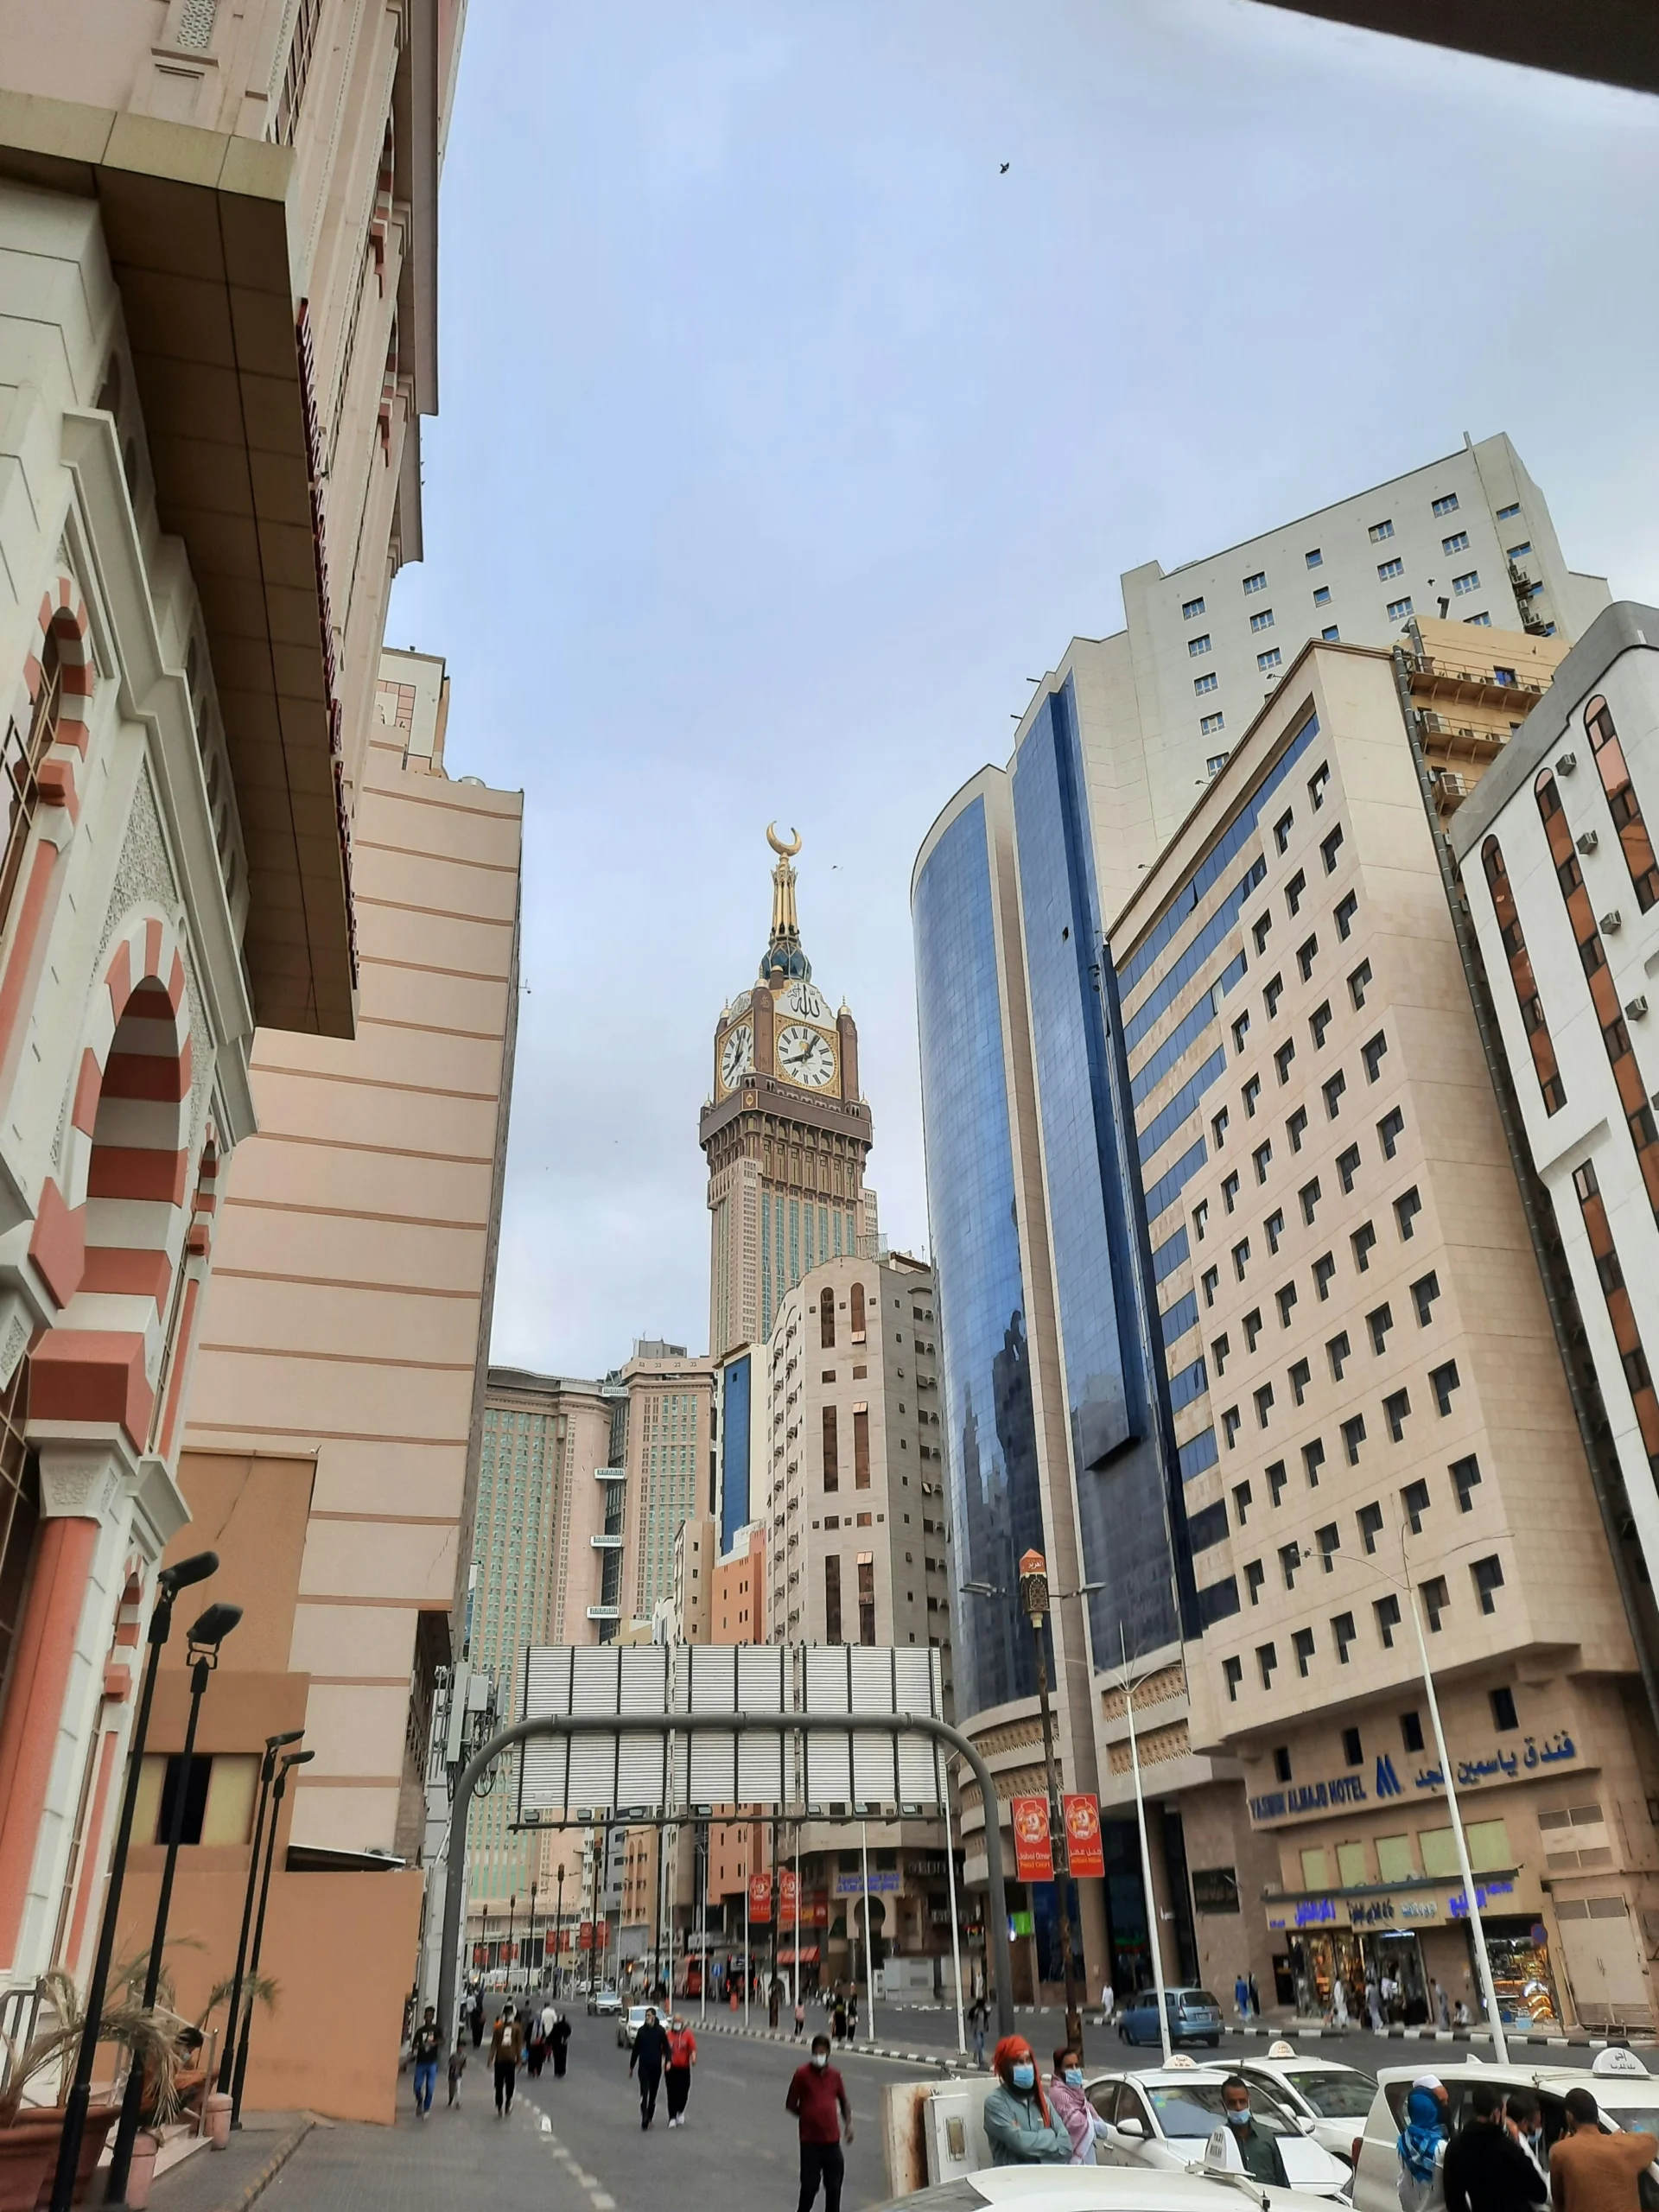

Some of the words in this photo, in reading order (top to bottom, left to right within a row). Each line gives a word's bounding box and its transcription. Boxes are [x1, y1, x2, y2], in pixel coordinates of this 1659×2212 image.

[1458, 1749, 1518, 1785] ياسمين
[1523, 1730, 1577, 1769] فندق
[1328, 1775, 1367, 1806] HOTEL
